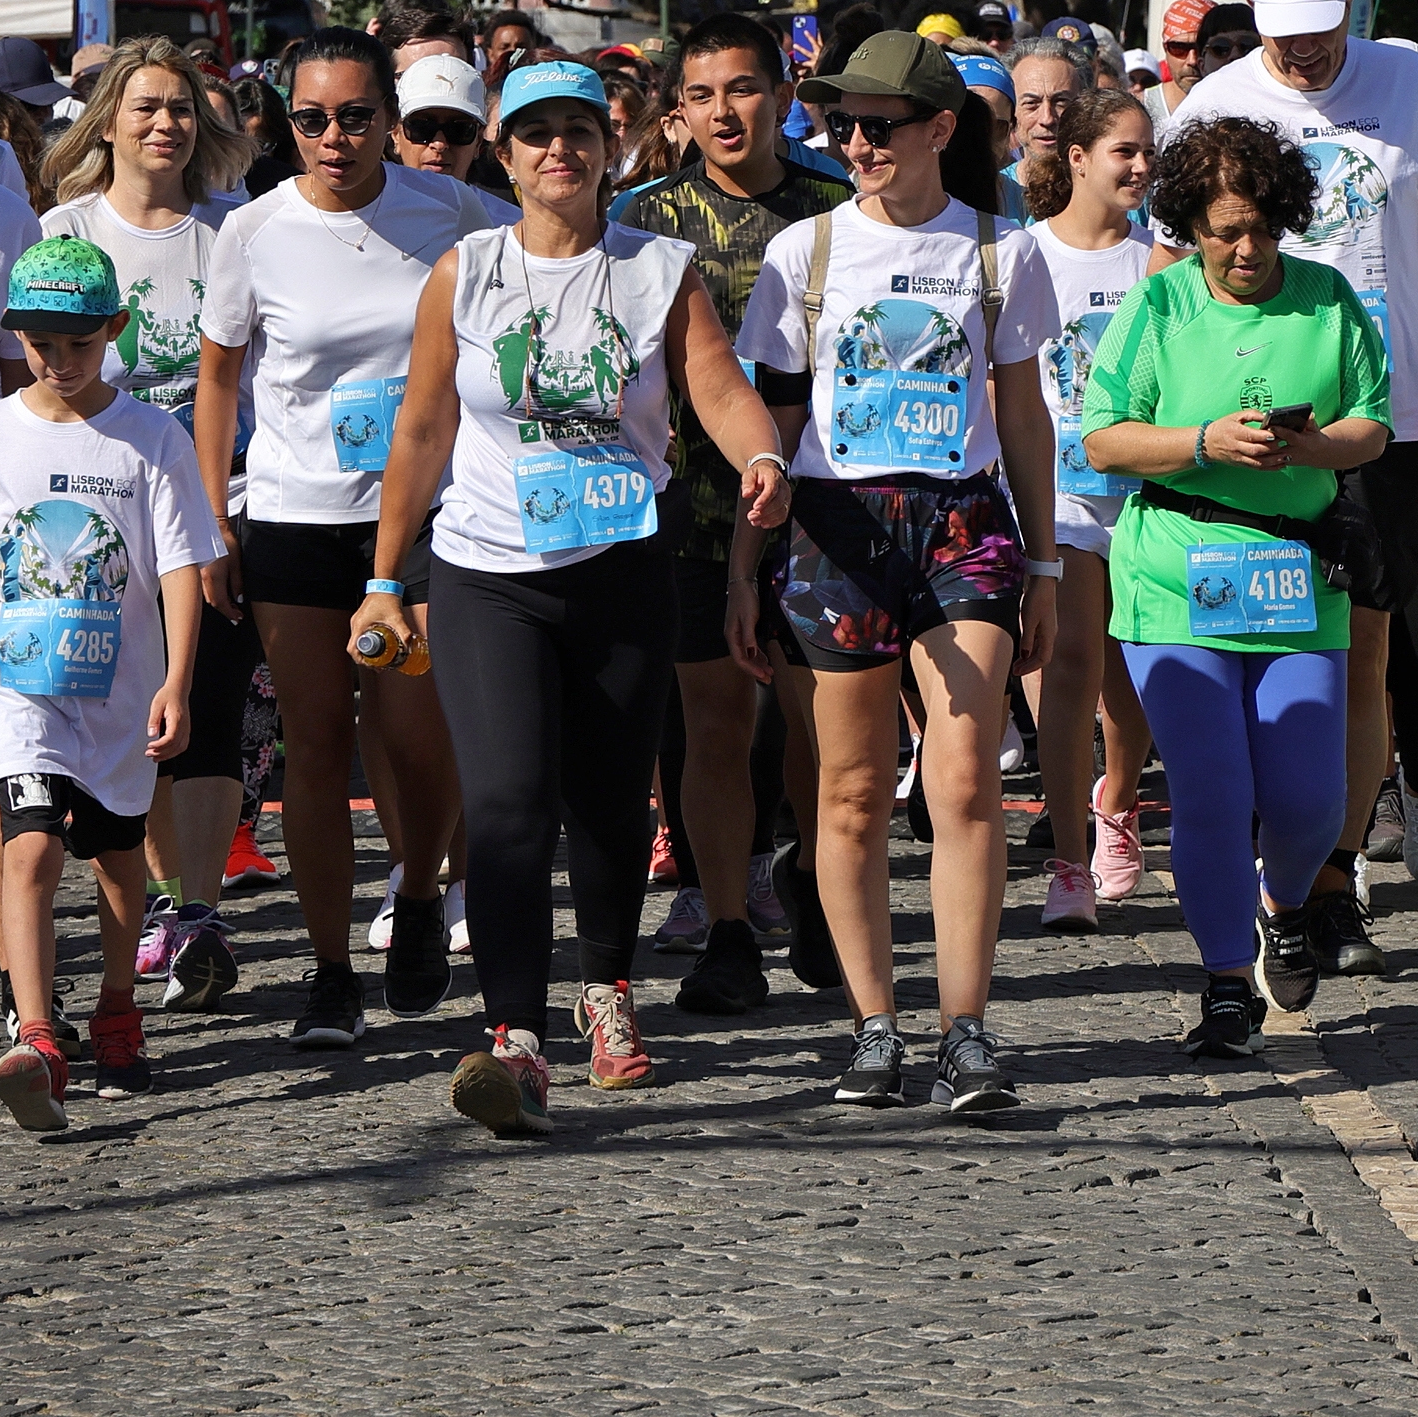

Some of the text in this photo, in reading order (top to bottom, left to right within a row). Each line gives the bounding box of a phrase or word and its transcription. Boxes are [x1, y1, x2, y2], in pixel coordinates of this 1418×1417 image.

[1320, 119, 1356, 132] LISBON
[1321, 123, 1380, 138] MARATHON
[26, 280, 84, 293] MINECRAFT
[912, 276, 954, 287] LISBON
[912, 286, 980, 297] MARATHON
[1106, 291, 1126, 300] LISB
[1244, 377, 1267, 386] SCP
[894, 401, 959, 437] 4300
[545, 424, 619, 441] MARATHON
[577, 452, 638, 467] CAMINHADA
[71, 474, 113, 487] LISBON
[70, 483, 135, 499] MARATHON
[583, 472, 646, 509] 4379
[1247, 548, 1303, 561] CAMINHADA
[1249, 568, 1308, 600] 4183
[59, 607, 115, 621] CAMINHADA
[56, 629, 114, 664] 4285
